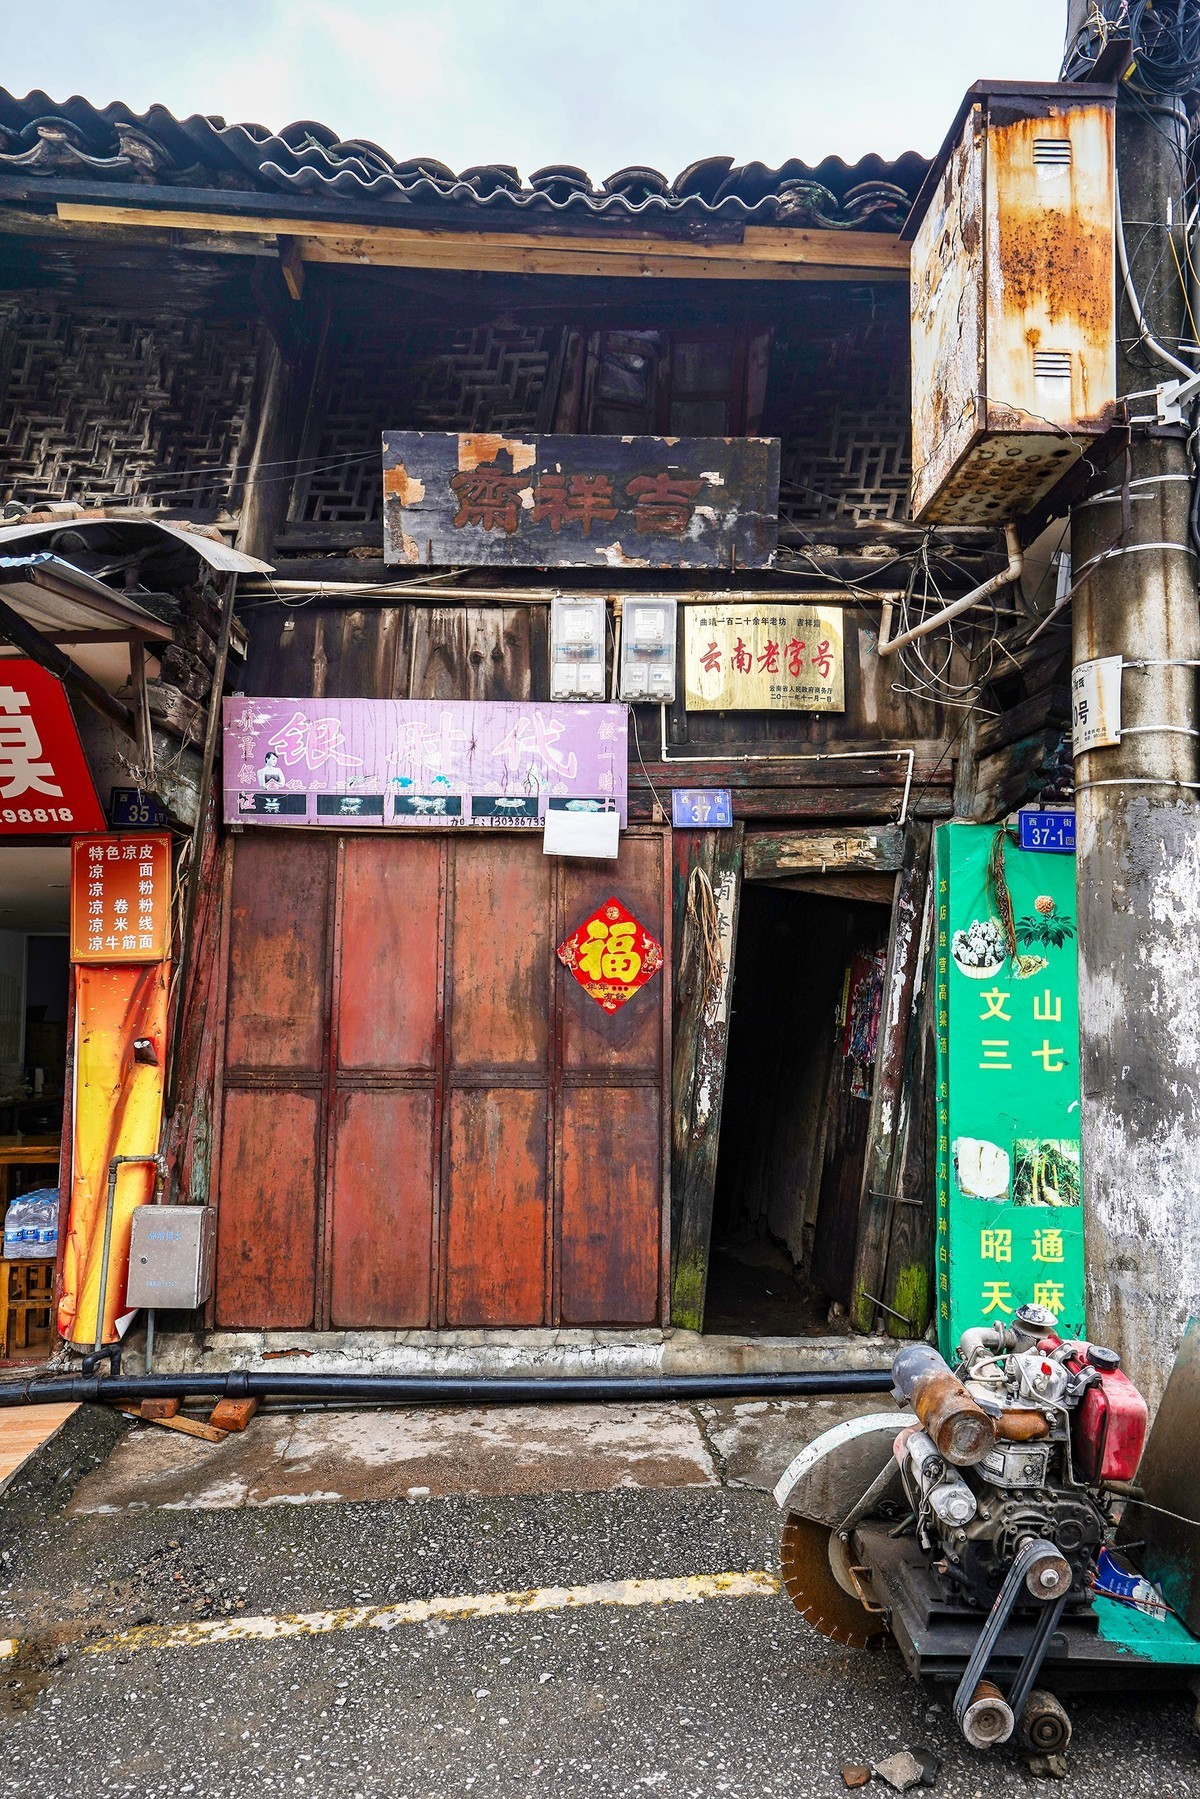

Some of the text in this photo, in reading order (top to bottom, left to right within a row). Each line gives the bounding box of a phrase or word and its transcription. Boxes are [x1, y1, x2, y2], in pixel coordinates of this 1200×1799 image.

[700, 637, 834, 679] 云南老字号
[0, 807, 74, 824] 98818
[128, 804, 150, 823] 35
[691, 805, 711, 822] 37
[1028, 817, 1072, 828] 西门街
[1032, 828, 1064, 846] 37-1
[88, 844, 154, 861] 特色凉皮
[88, 934, 154, 951] 凉牛筋面
[579, 918, 641, 983] 福
